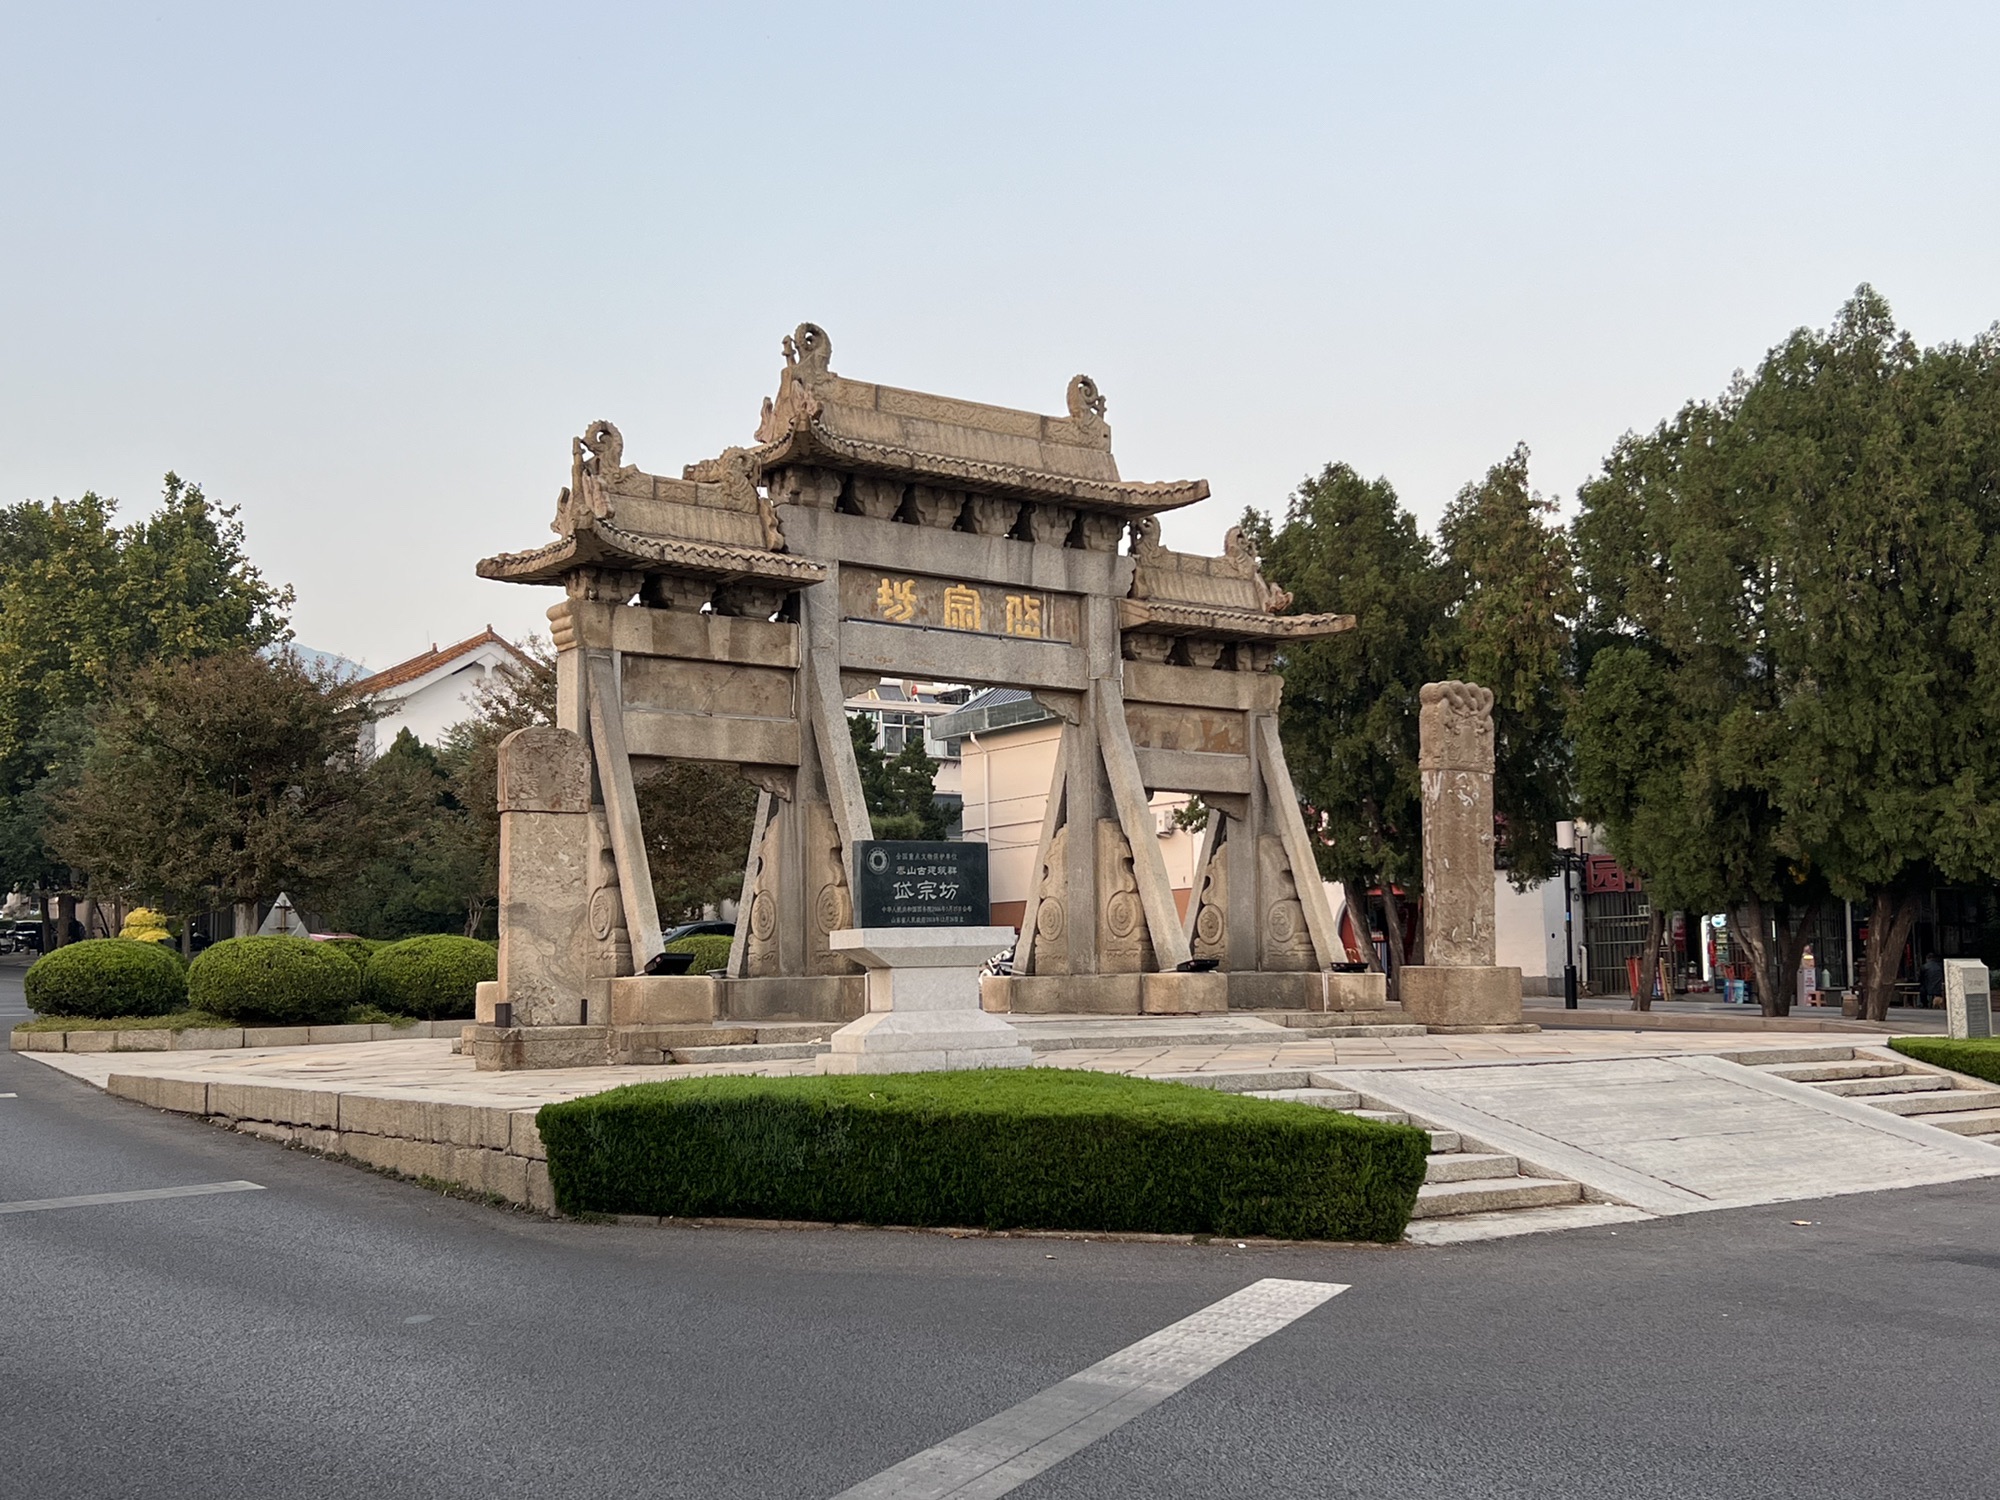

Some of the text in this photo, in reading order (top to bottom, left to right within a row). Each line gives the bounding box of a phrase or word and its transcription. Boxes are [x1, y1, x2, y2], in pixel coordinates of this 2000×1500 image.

[896, 866, 958, 875] 泰山古建筑群
[892, 880, 960, 901] 岱宗坊
